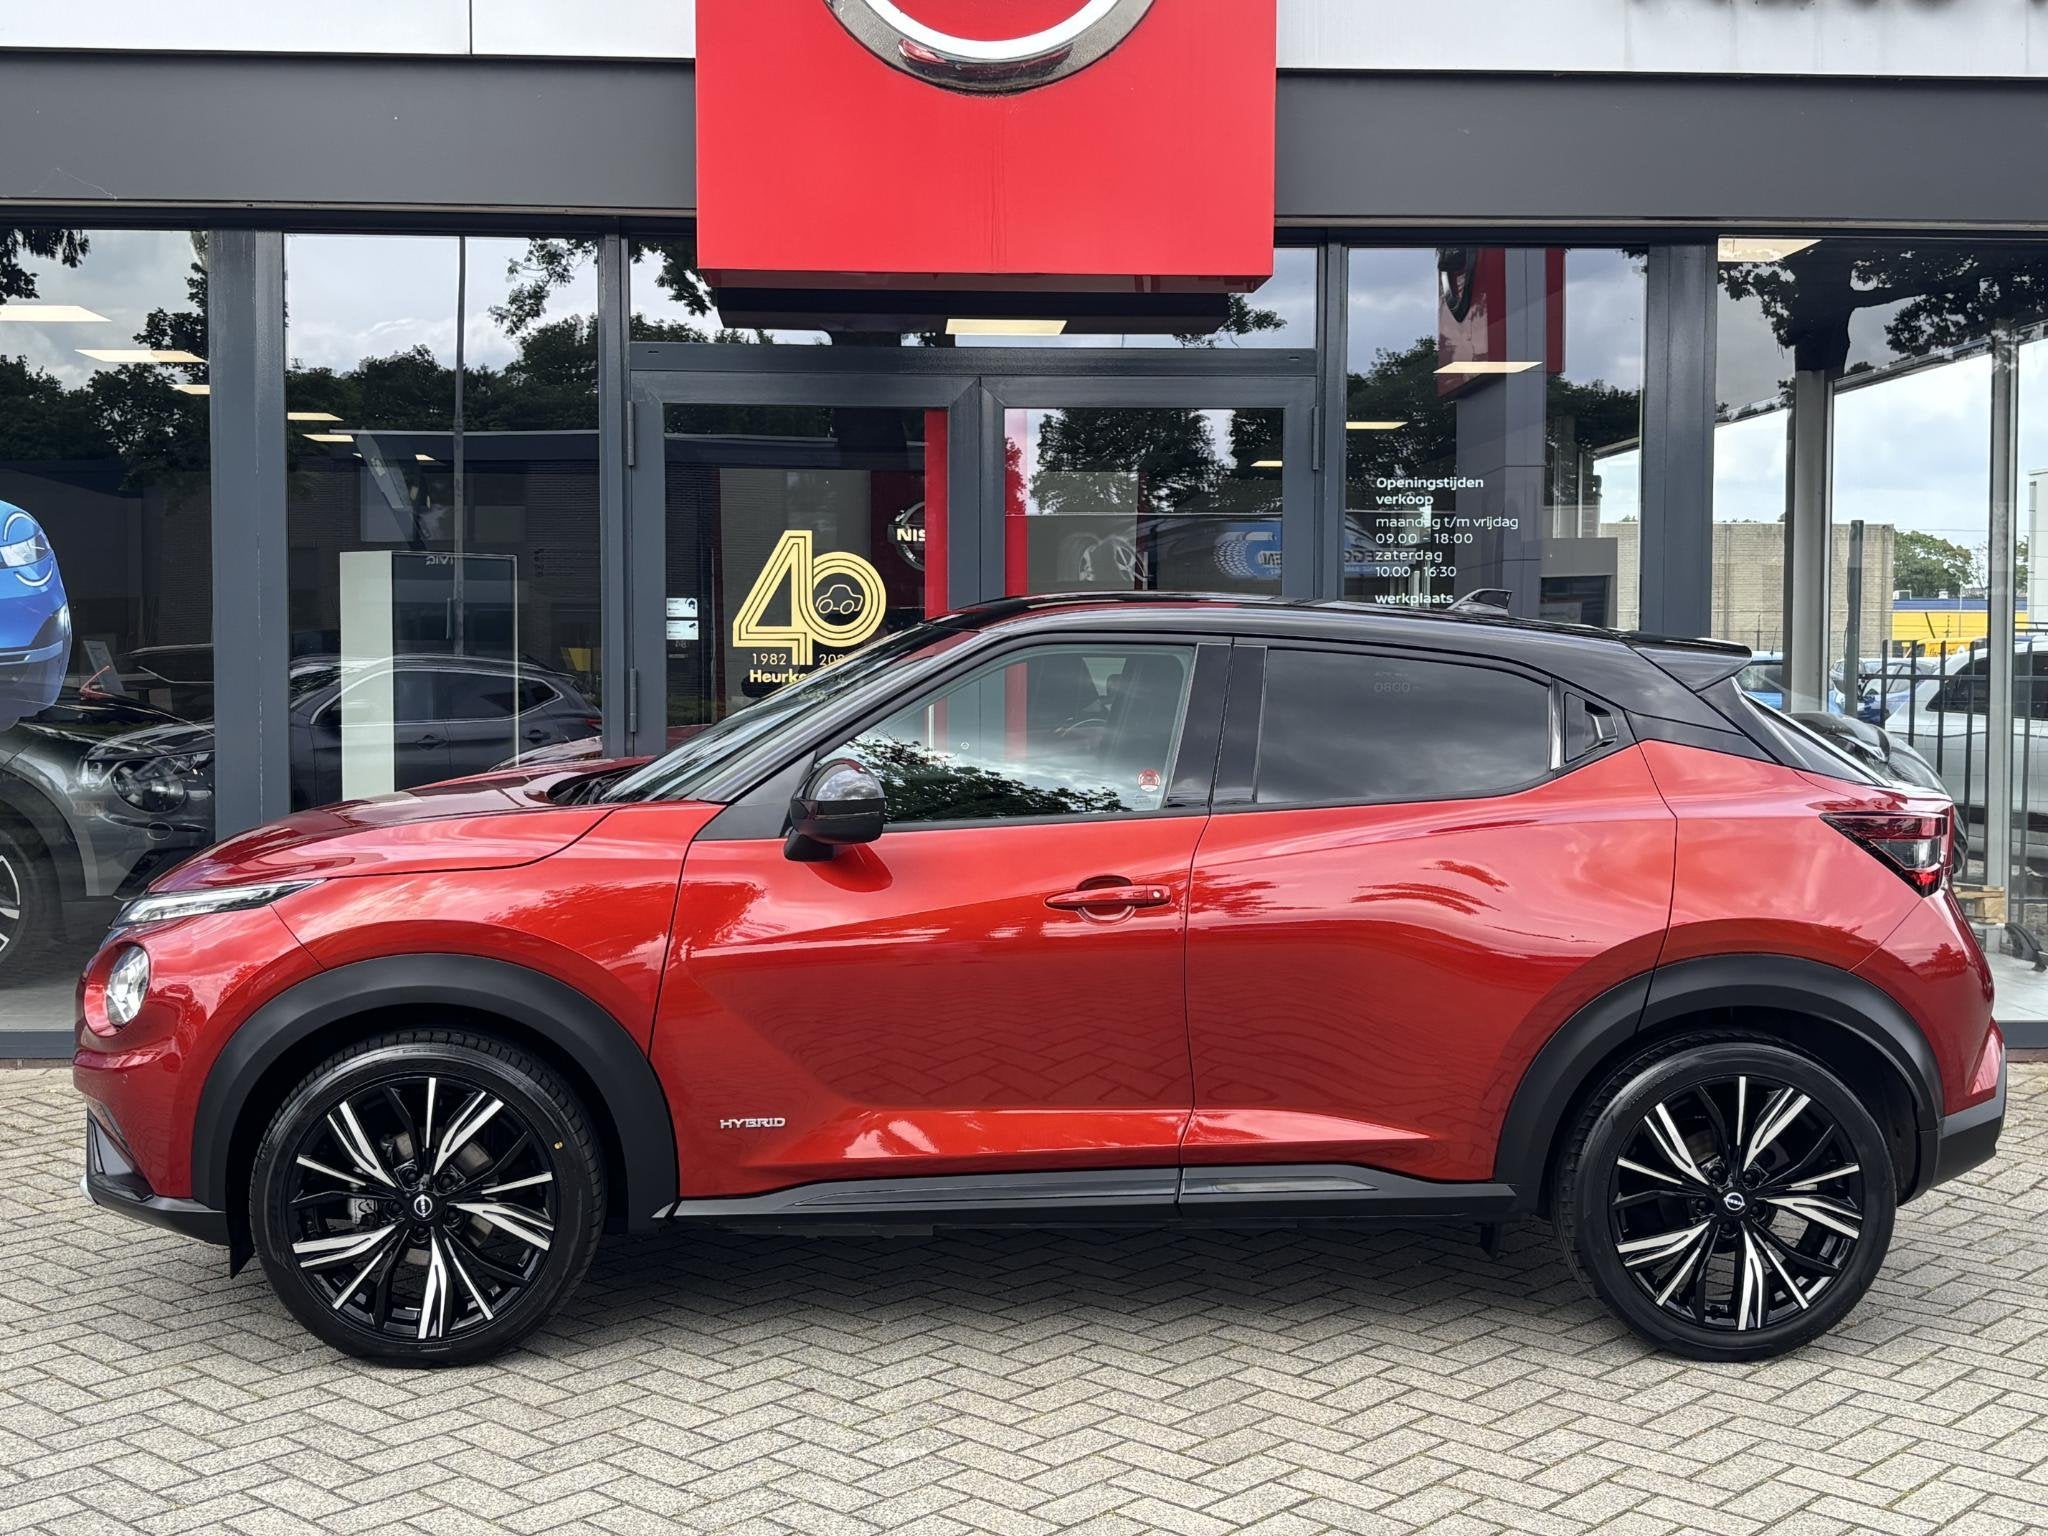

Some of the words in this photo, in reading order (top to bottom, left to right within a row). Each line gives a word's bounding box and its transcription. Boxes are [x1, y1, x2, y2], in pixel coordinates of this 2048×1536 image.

[1376, 477, 1484, 491] Openingstijden
[1375, 493, 1434, 506] verkoop
[1375, 516, 1441, 530] maandg
[1443, 516, 1470, 529] t/m
[1473, 516, 1519, 530] vrijdag
[896, 528, 926, 542] NIS
[1375, 533, 1417, 544] 09.00
[1434, 533, 1473, 544] 18:00
[1375, 549, 1443, 563] zaterdag
[1375, 566, 1411, 577] 10.00
[733, 530, 887, 666] 40
[1374, 592, 1454, 607] werkplaats
[752, 653, 787, 665] 1982
[719, 1117, 787, 1129] HYBRID
